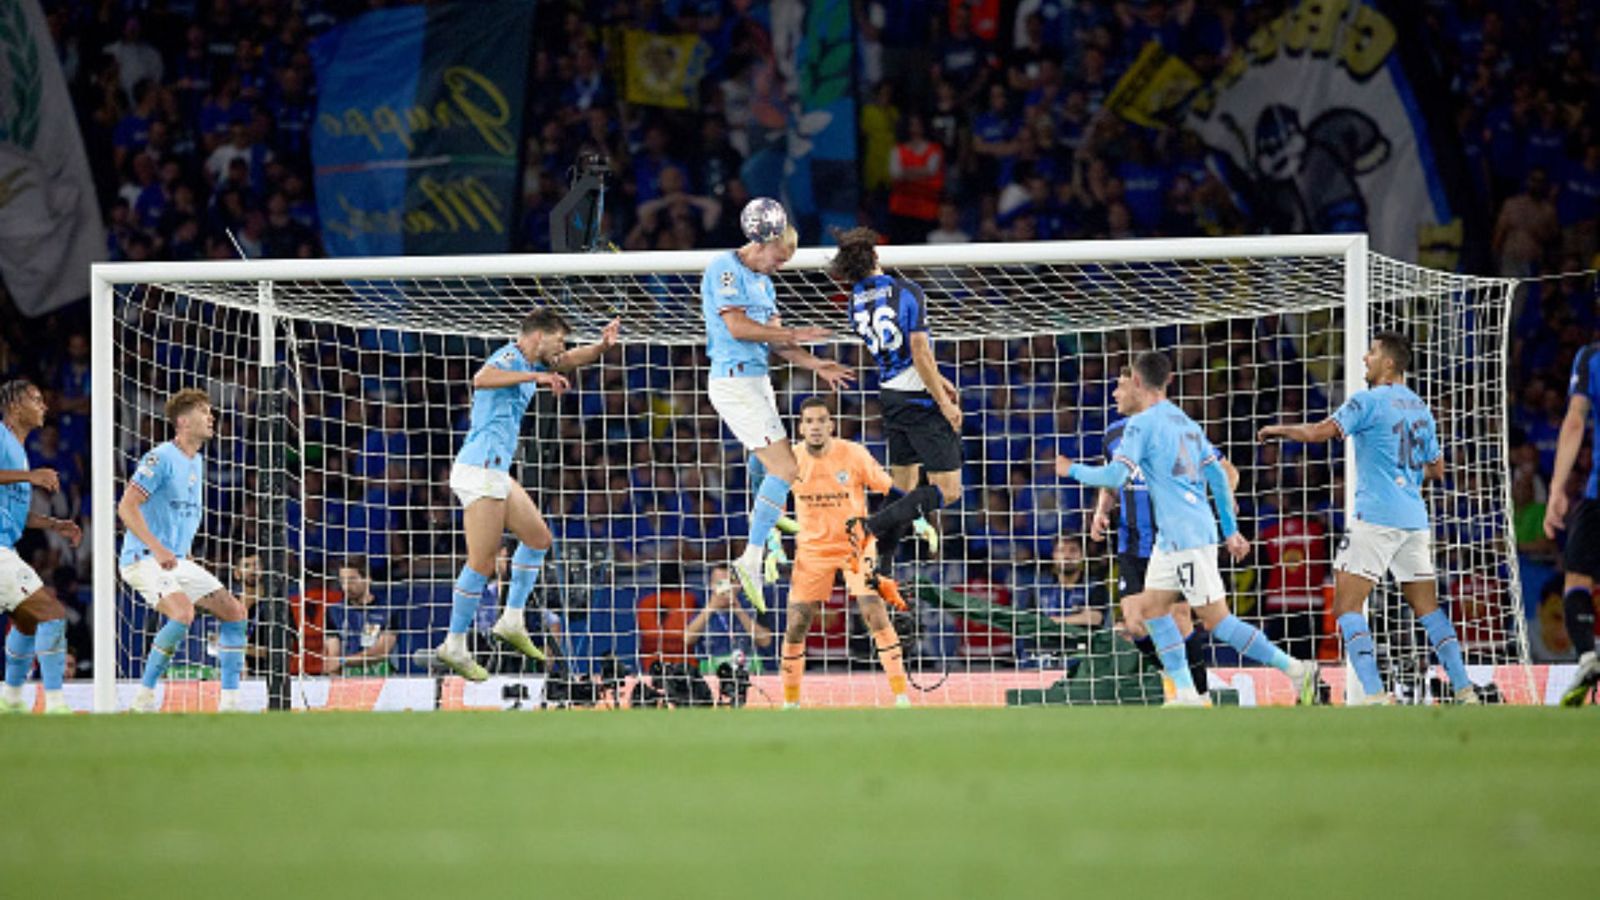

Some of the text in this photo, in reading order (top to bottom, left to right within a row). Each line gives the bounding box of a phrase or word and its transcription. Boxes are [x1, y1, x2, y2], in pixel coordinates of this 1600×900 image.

[853, 305, 903, 356] 36
[1171, 431, 1200, 485] 47
[1392, 417, 1429, 472] 16
